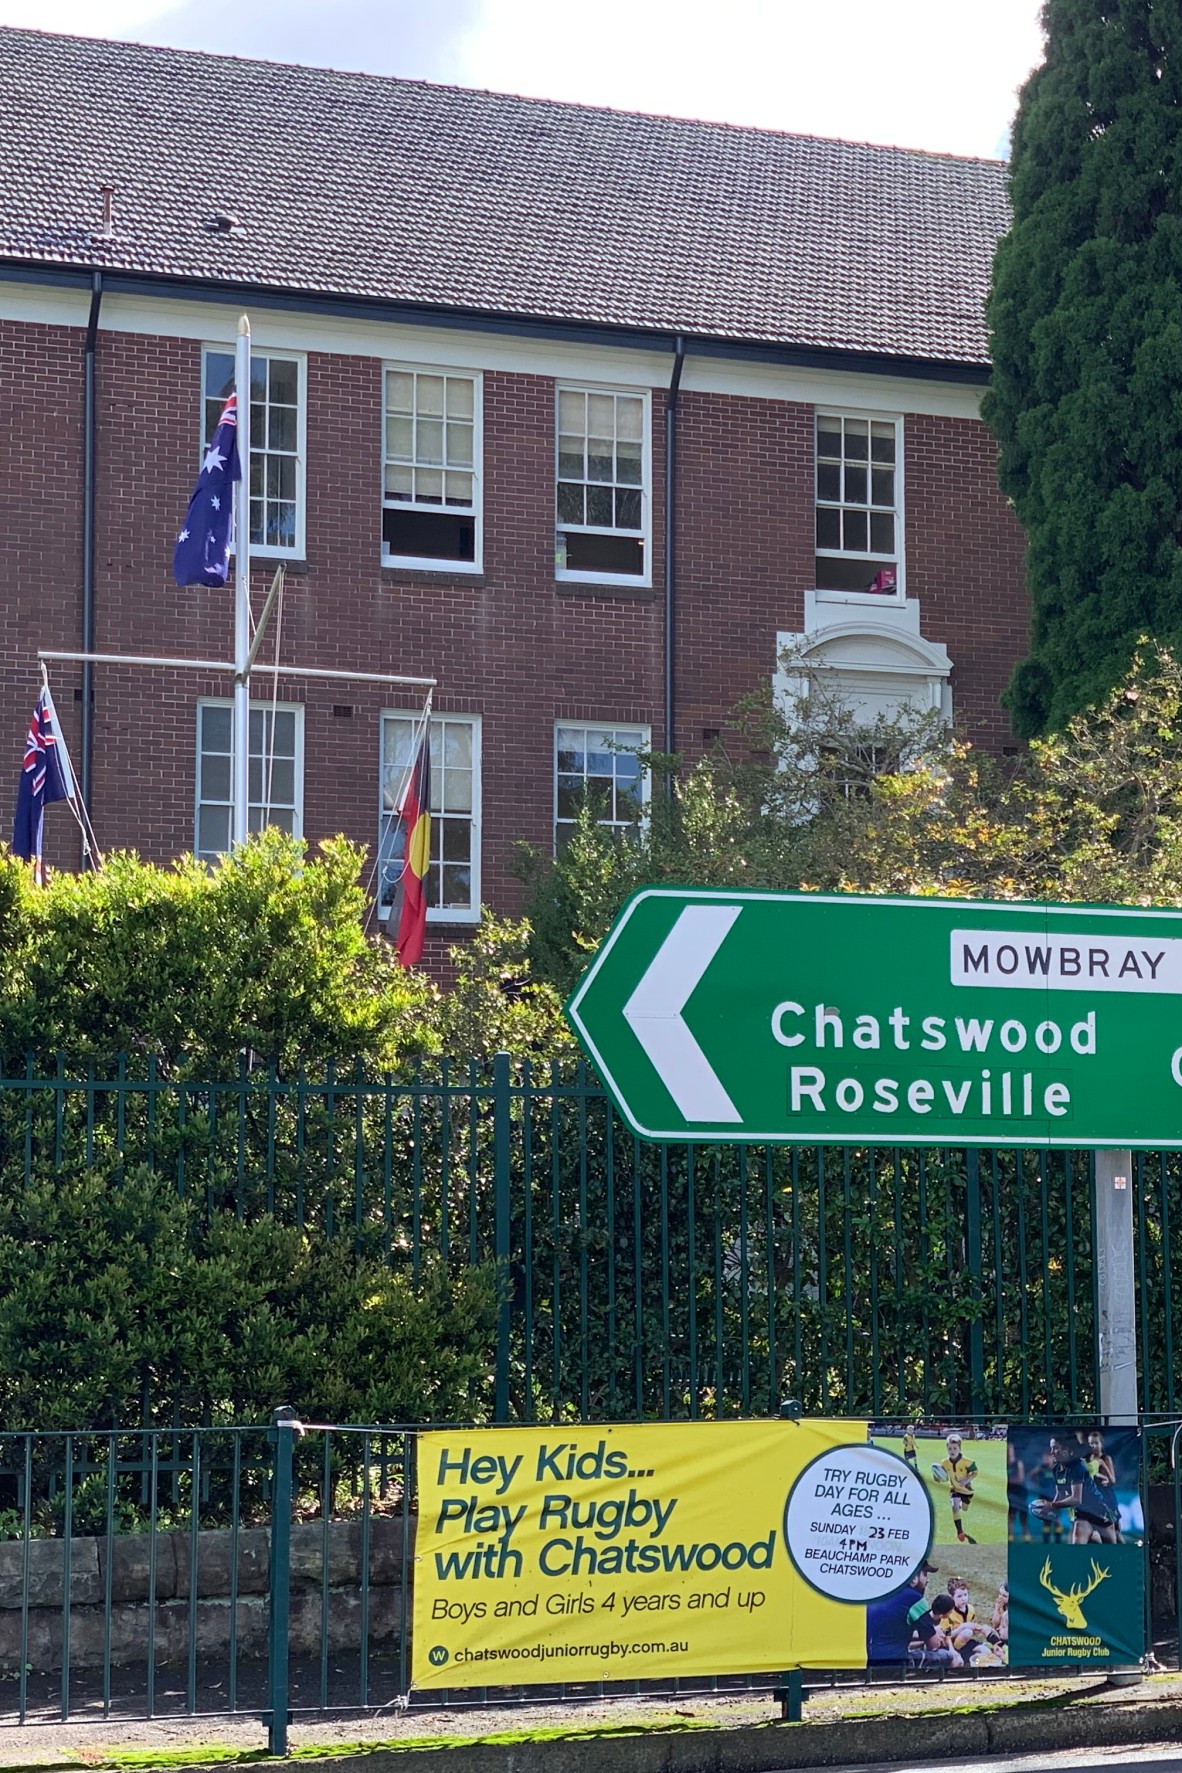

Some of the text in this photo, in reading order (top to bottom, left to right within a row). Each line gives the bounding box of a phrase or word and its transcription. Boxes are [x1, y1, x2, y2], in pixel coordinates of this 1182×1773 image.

[962, 944, 1166, 980] MOWBRAY
[770, 1001, 1097, 1056] Chatswood
[789, 1065, 1072, 1117] Roseville
[436, 1440, 655, 1495] Hey Kids...
[823, 1468, 908, 1489] TRY RUGBY
[814, 1484, 911, 1506] DAY FOR ALL
[435, 1488, 678, 1543] Play Rugby
[830, 1502, 874, 1519] AGES
[809, 1521, 857, 1535] SUNDAY
[868, 1526, 885, 1540] 23
[887, 1528, 910, 1541] FEB
[434, 1530, 777, 1581] with Chatswood
[804, 1548, 911, 1567] BEAUCHAMP PARK
[820, 1563, 894, 1579] CHATSWOOD
[431, 1587, 766, 1624] Boys and Girls 4 years and up
[453, 1640, 689, 1663] chatswoodjuniorrugby.com.au
[1041, 1646, 1110, 1658] Junior Rugby Club
[1050, 1636, 1101, 1646] CHATSWOOD
